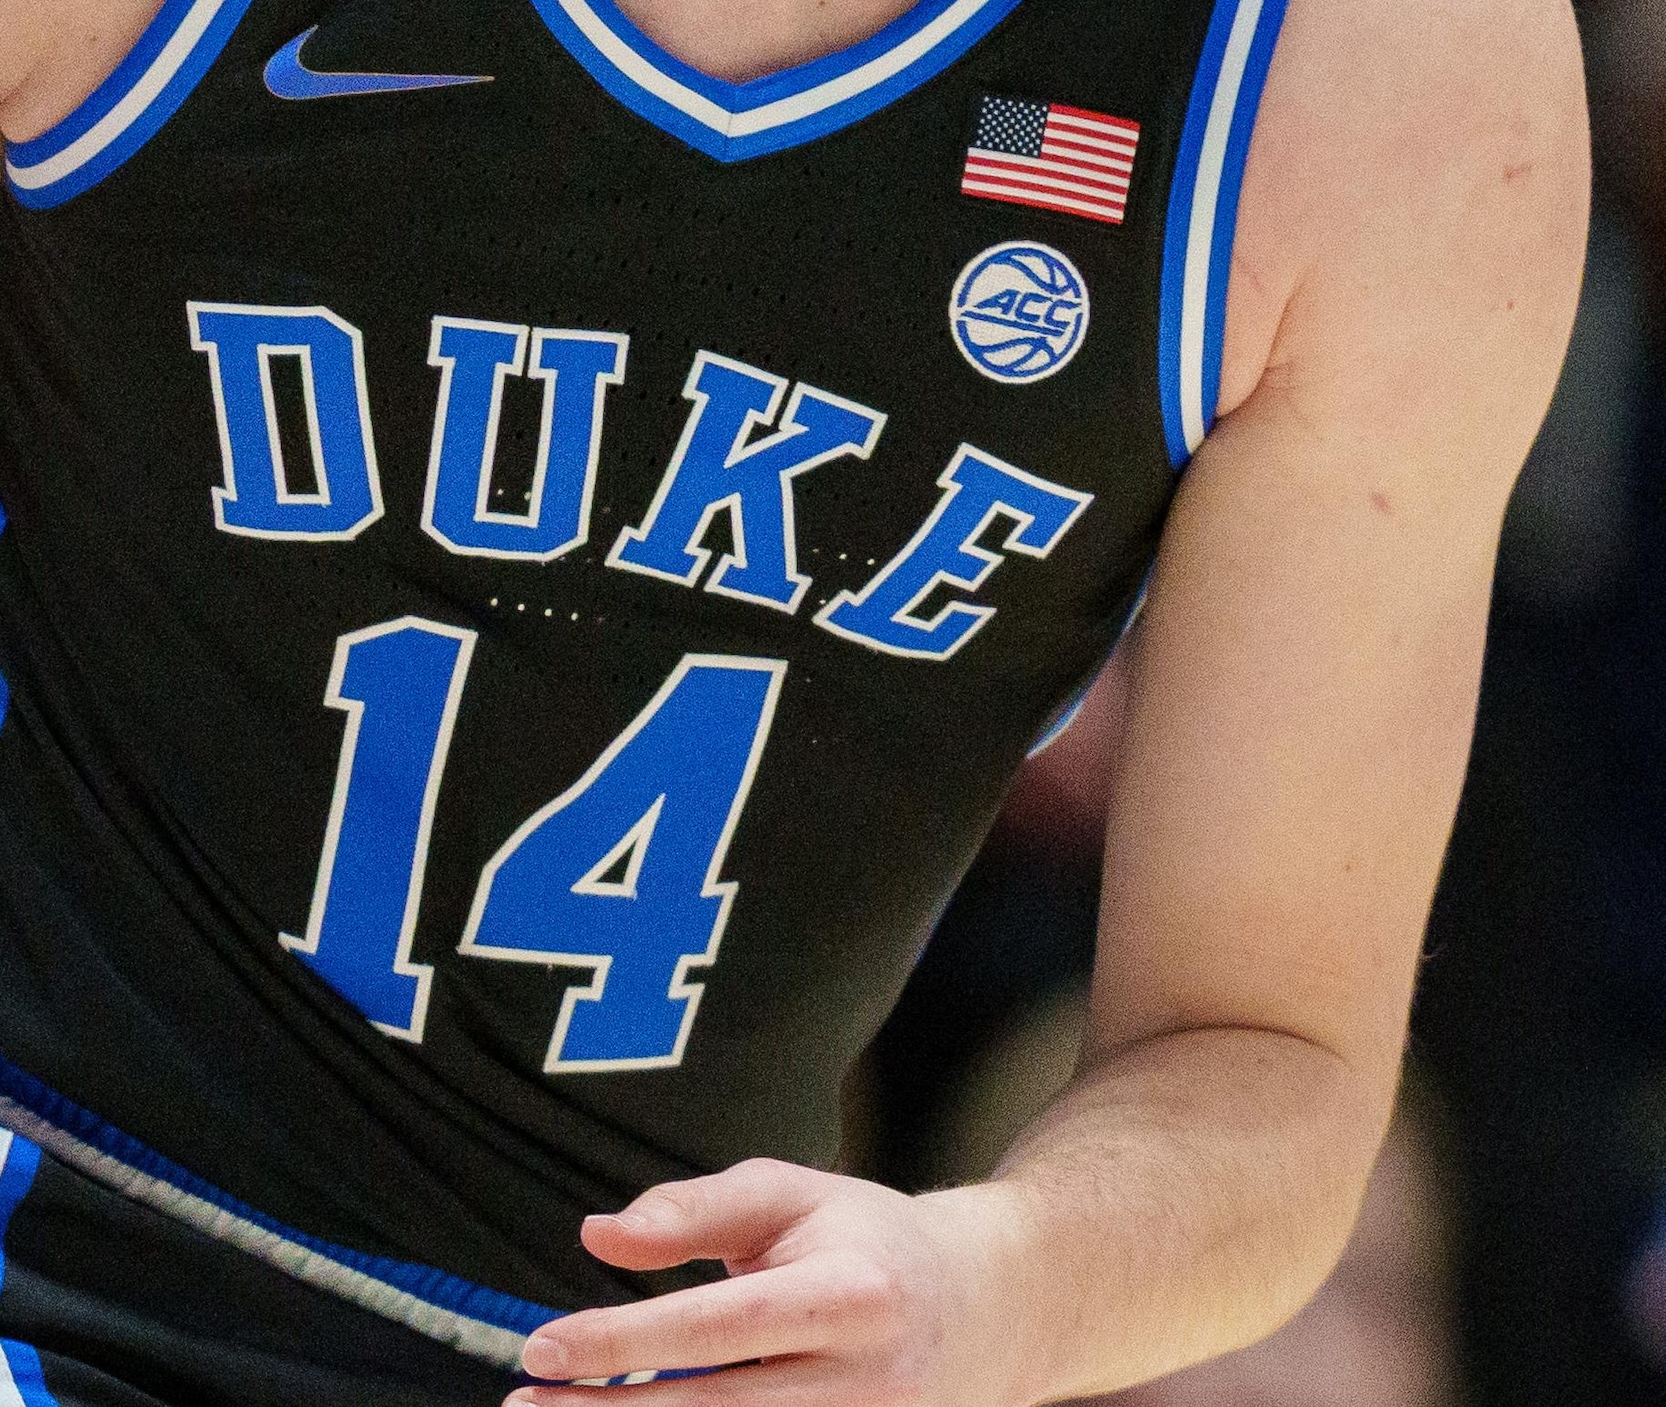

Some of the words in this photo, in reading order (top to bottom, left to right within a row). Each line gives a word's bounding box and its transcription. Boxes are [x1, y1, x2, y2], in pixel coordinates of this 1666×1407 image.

[186, 300, 1095, 660] DUKE
[975, 290, 1081, 327] ACC
[278, 614, 789, 1074] 14
